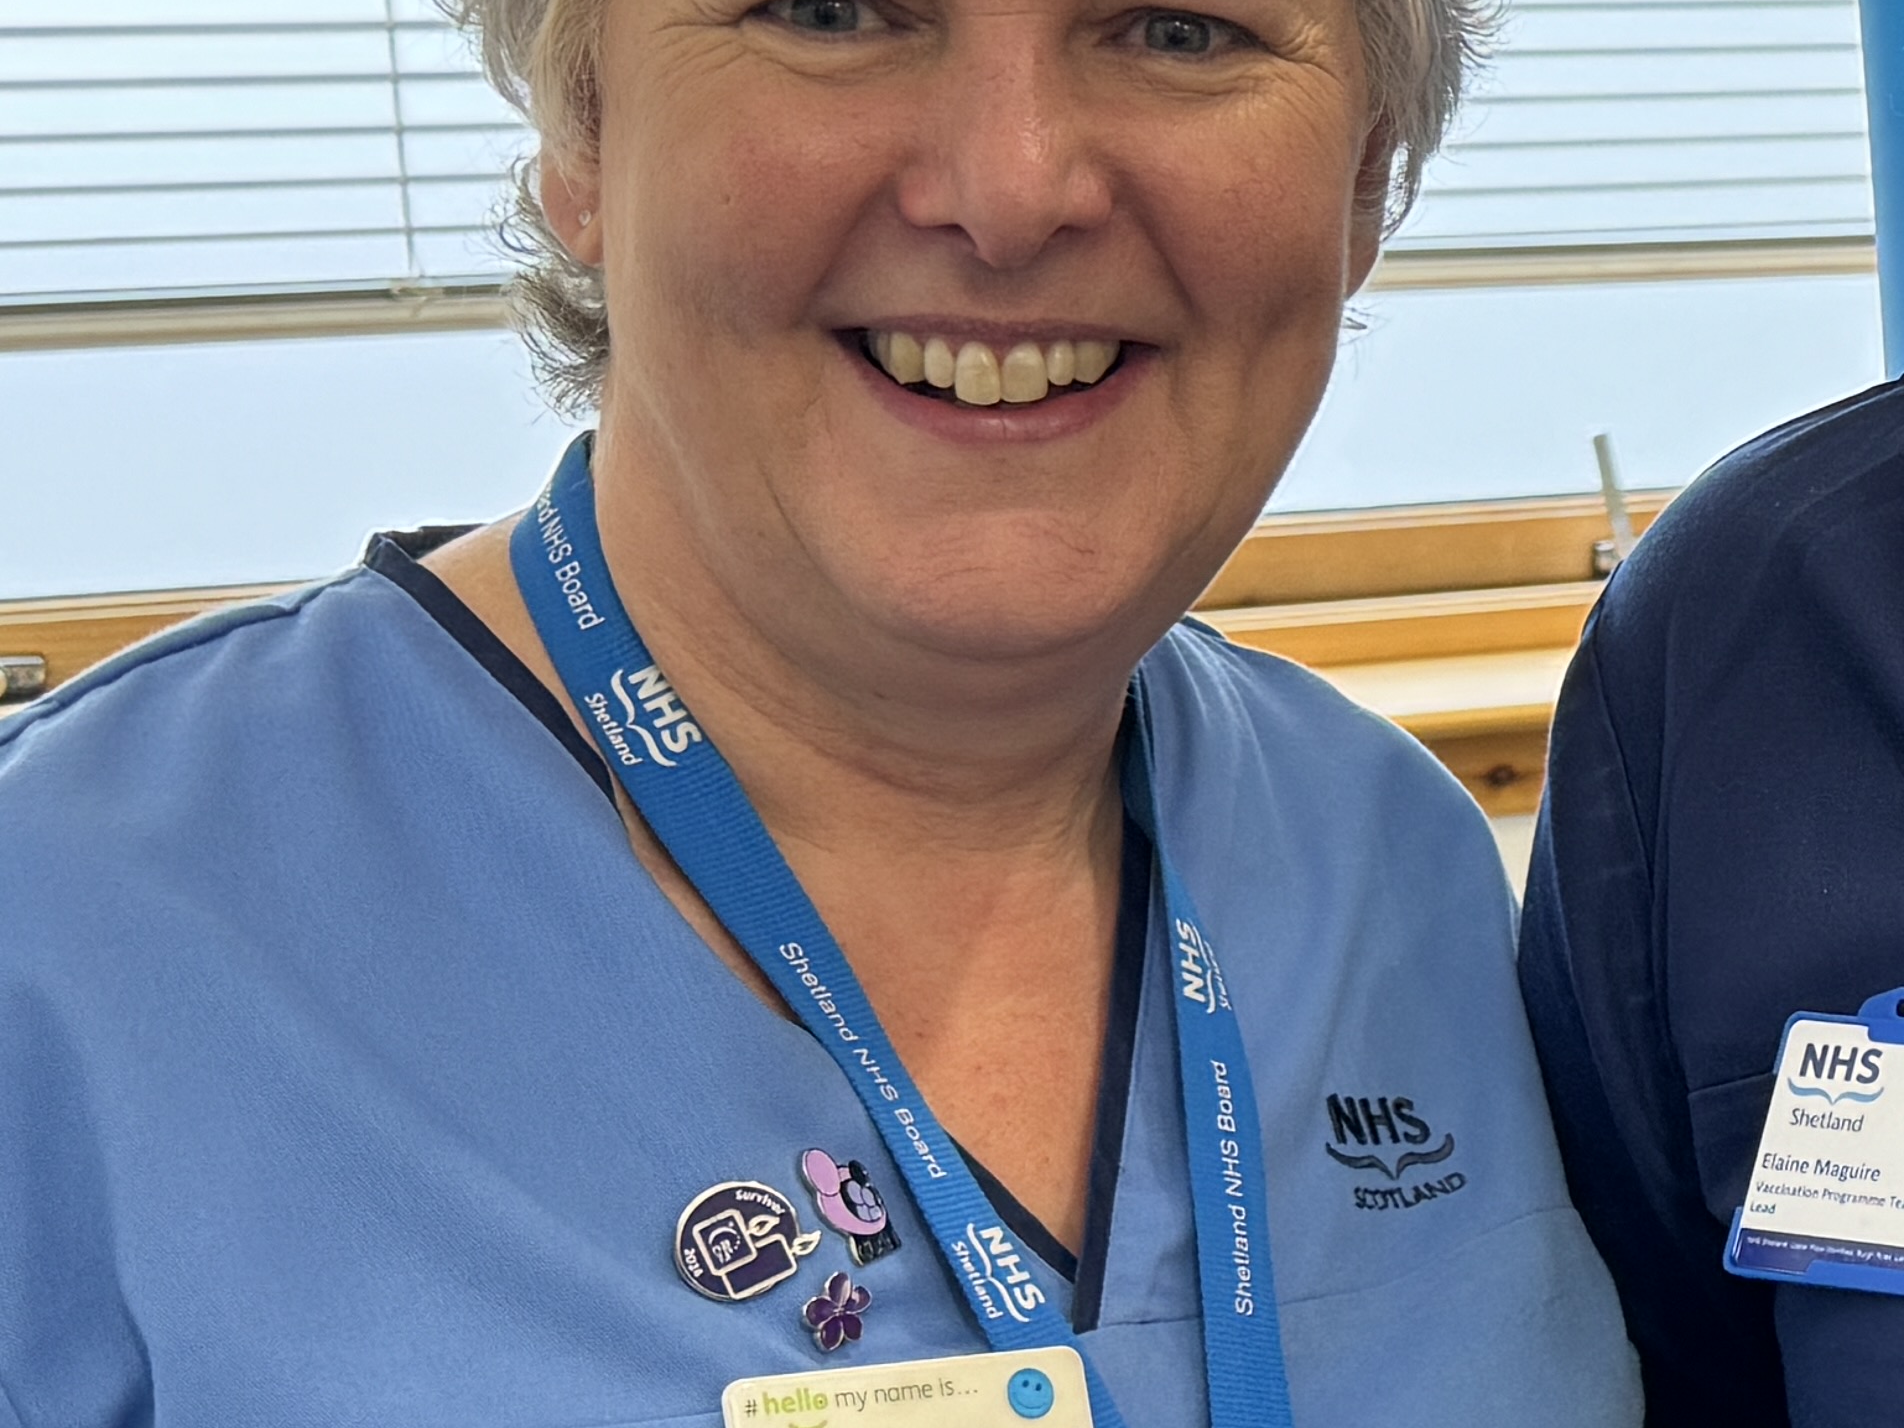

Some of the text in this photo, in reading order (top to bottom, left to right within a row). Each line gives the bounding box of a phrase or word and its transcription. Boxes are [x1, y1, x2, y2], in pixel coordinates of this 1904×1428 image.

[555, 560, 605, 631] Board
[584, 692, 643, 766] Shetland
[628, 664, 703, 753] NHS
[1175, 918, 1206, 1003] NHS
[779, 941, 947, 1180] Shetland NHS Board
[1799, 1042, 1884, 1085] NHS
[1326, 1093, 1431, 1146] NHS
[1788, 1106, 1865, 1134] Shetland
[1210, 1059, 1253, 1317] Shetland NHS Board
[1353, 1171, 1467, 1211] SCOTLAND
[1755, 1180, 1819, 1200] Vaccination
[1821, 1187, 1887, 1207] Programme
[1761, 1152, 1882, 1183] Elaine Maguire
[1750, 1200, 1777, 1215] Lead
[951, 1240, 1003, 1320] Shetland
[979, 1225, 1046, 1311] NHS
[834, 1389, 868, 1413] my
[874, 1382, 934, 1405] name
